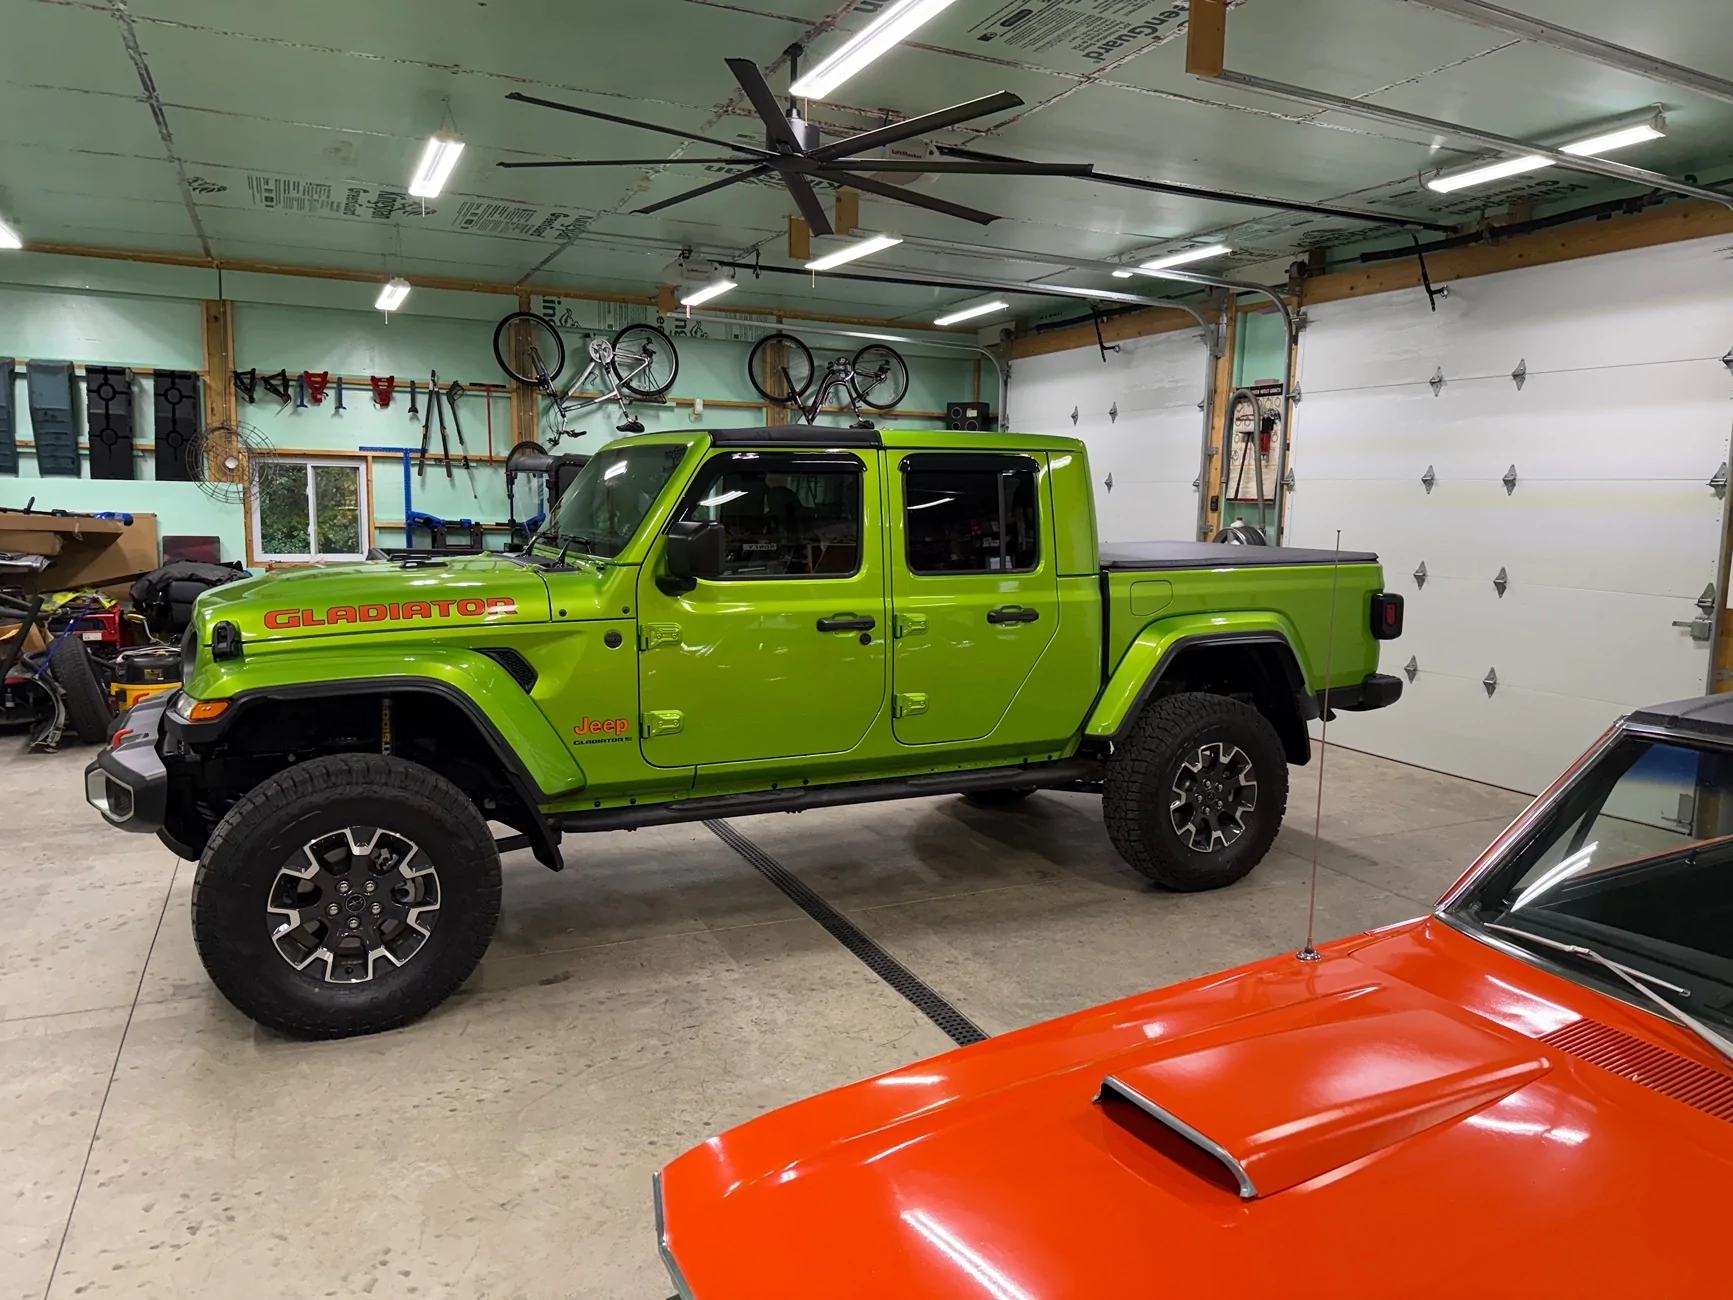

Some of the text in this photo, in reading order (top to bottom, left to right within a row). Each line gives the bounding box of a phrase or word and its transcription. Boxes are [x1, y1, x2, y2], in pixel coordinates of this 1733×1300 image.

[264, 597, 518, 629] GLADIATOR
[574, 716, 629, 735] Jeep
[573, 737, 624, 745] GLADIATOR
